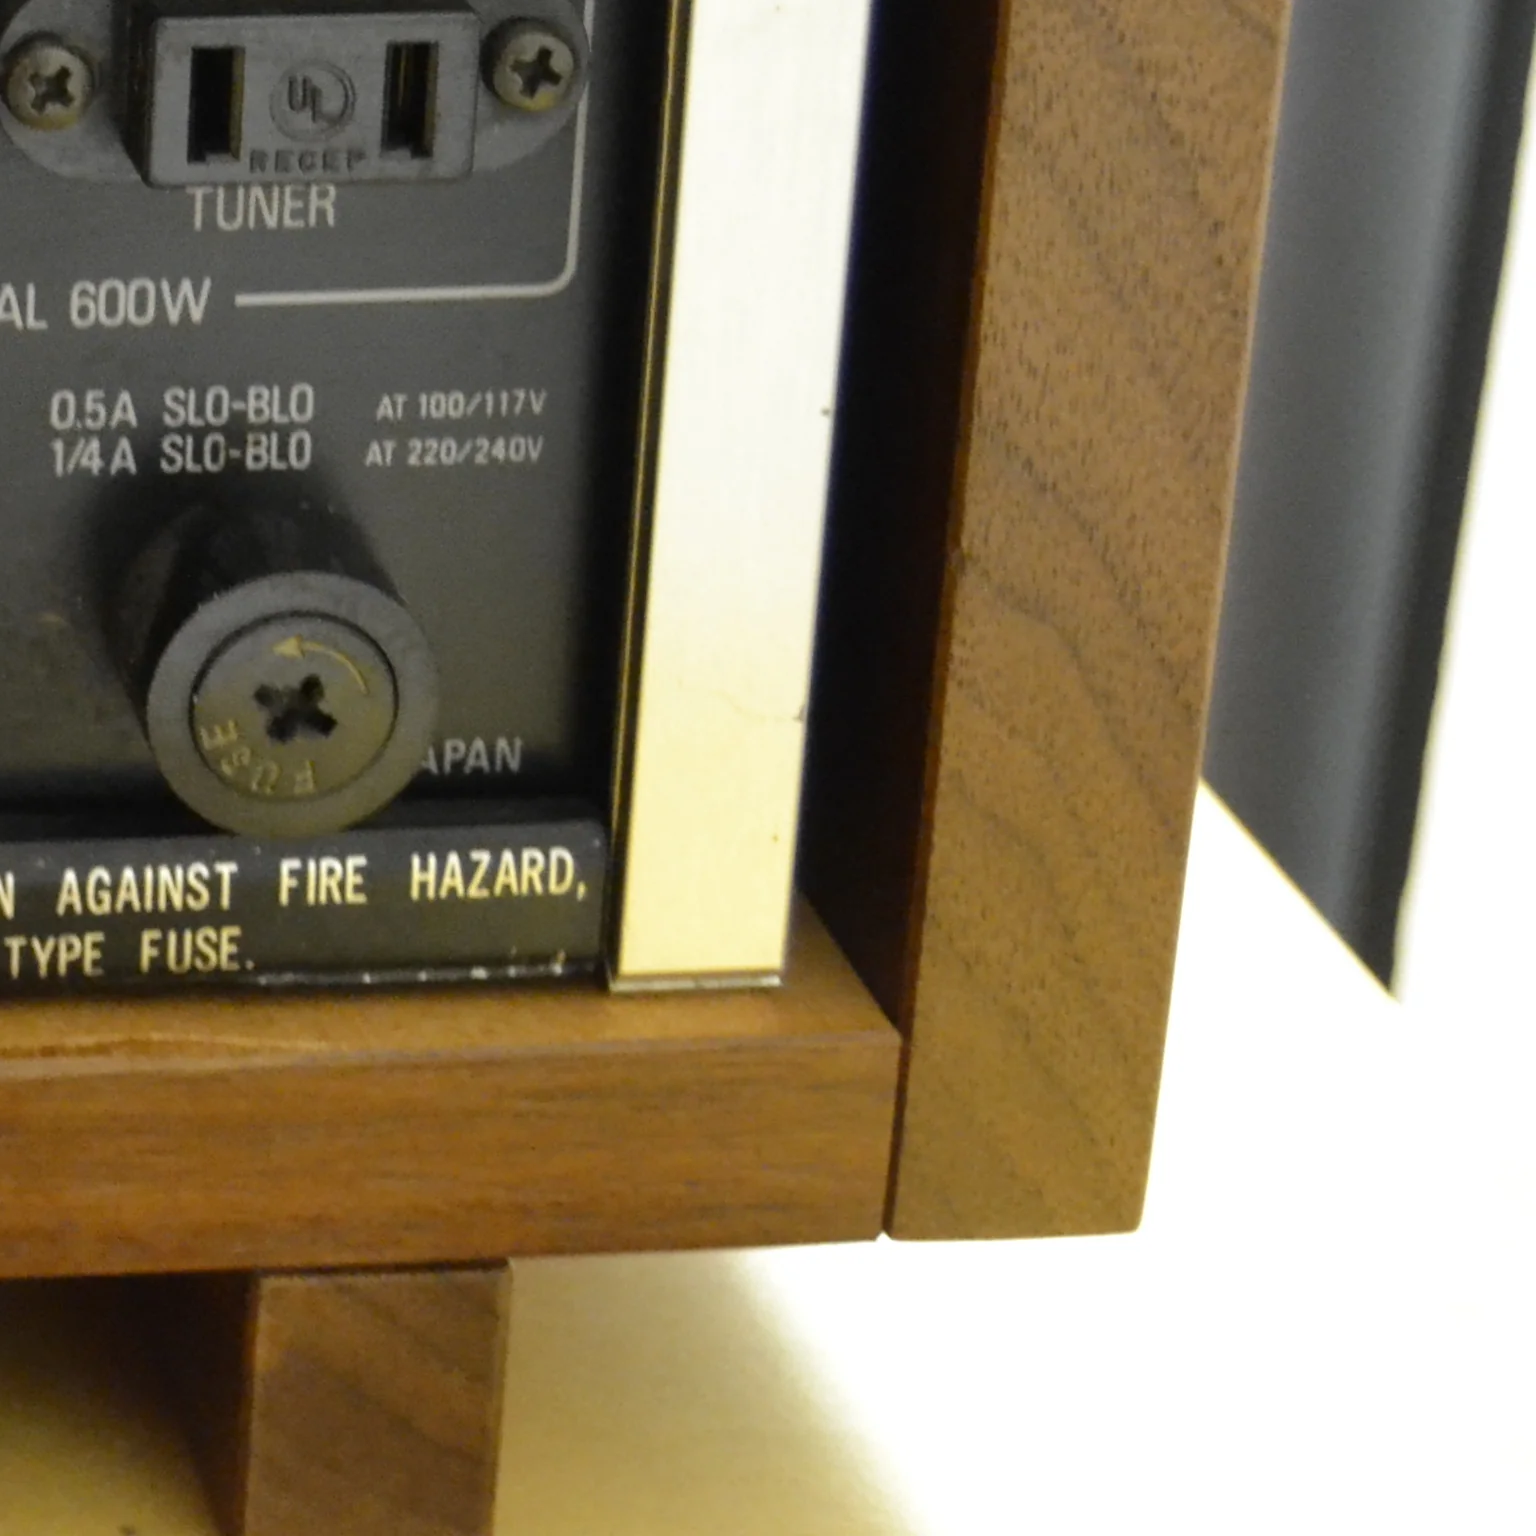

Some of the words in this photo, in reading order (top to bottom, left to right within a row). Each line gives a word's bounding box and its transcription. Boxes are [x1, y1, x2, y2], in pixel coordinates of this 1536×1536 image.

[186, 184, 338, 232] TUNER
[69, 277, 212, 328] 600W
[49, 389, 138, 431] 0.5A
[163, 382, 315, 427] SLO-BLO
[376, 393, 407, 420] AT
[418, 388, 546, 420] 100/117V
[50, 435, 136, 477] 1/4A
[160, 425, 314, 473] SLO-BLO
[364, 439, 396, 466] AT
[406, 435, 543, 467] 220/240V
[199, 718, 316, 795] FUSE
[421, 736, 523, 775] APAN
[57, 861, 239, 915] AGAINST
[279, 854, 368, 905] FIRE
[4, 933, 106, 981] TYPE
[139, 925, 257, 975] FUSE.
